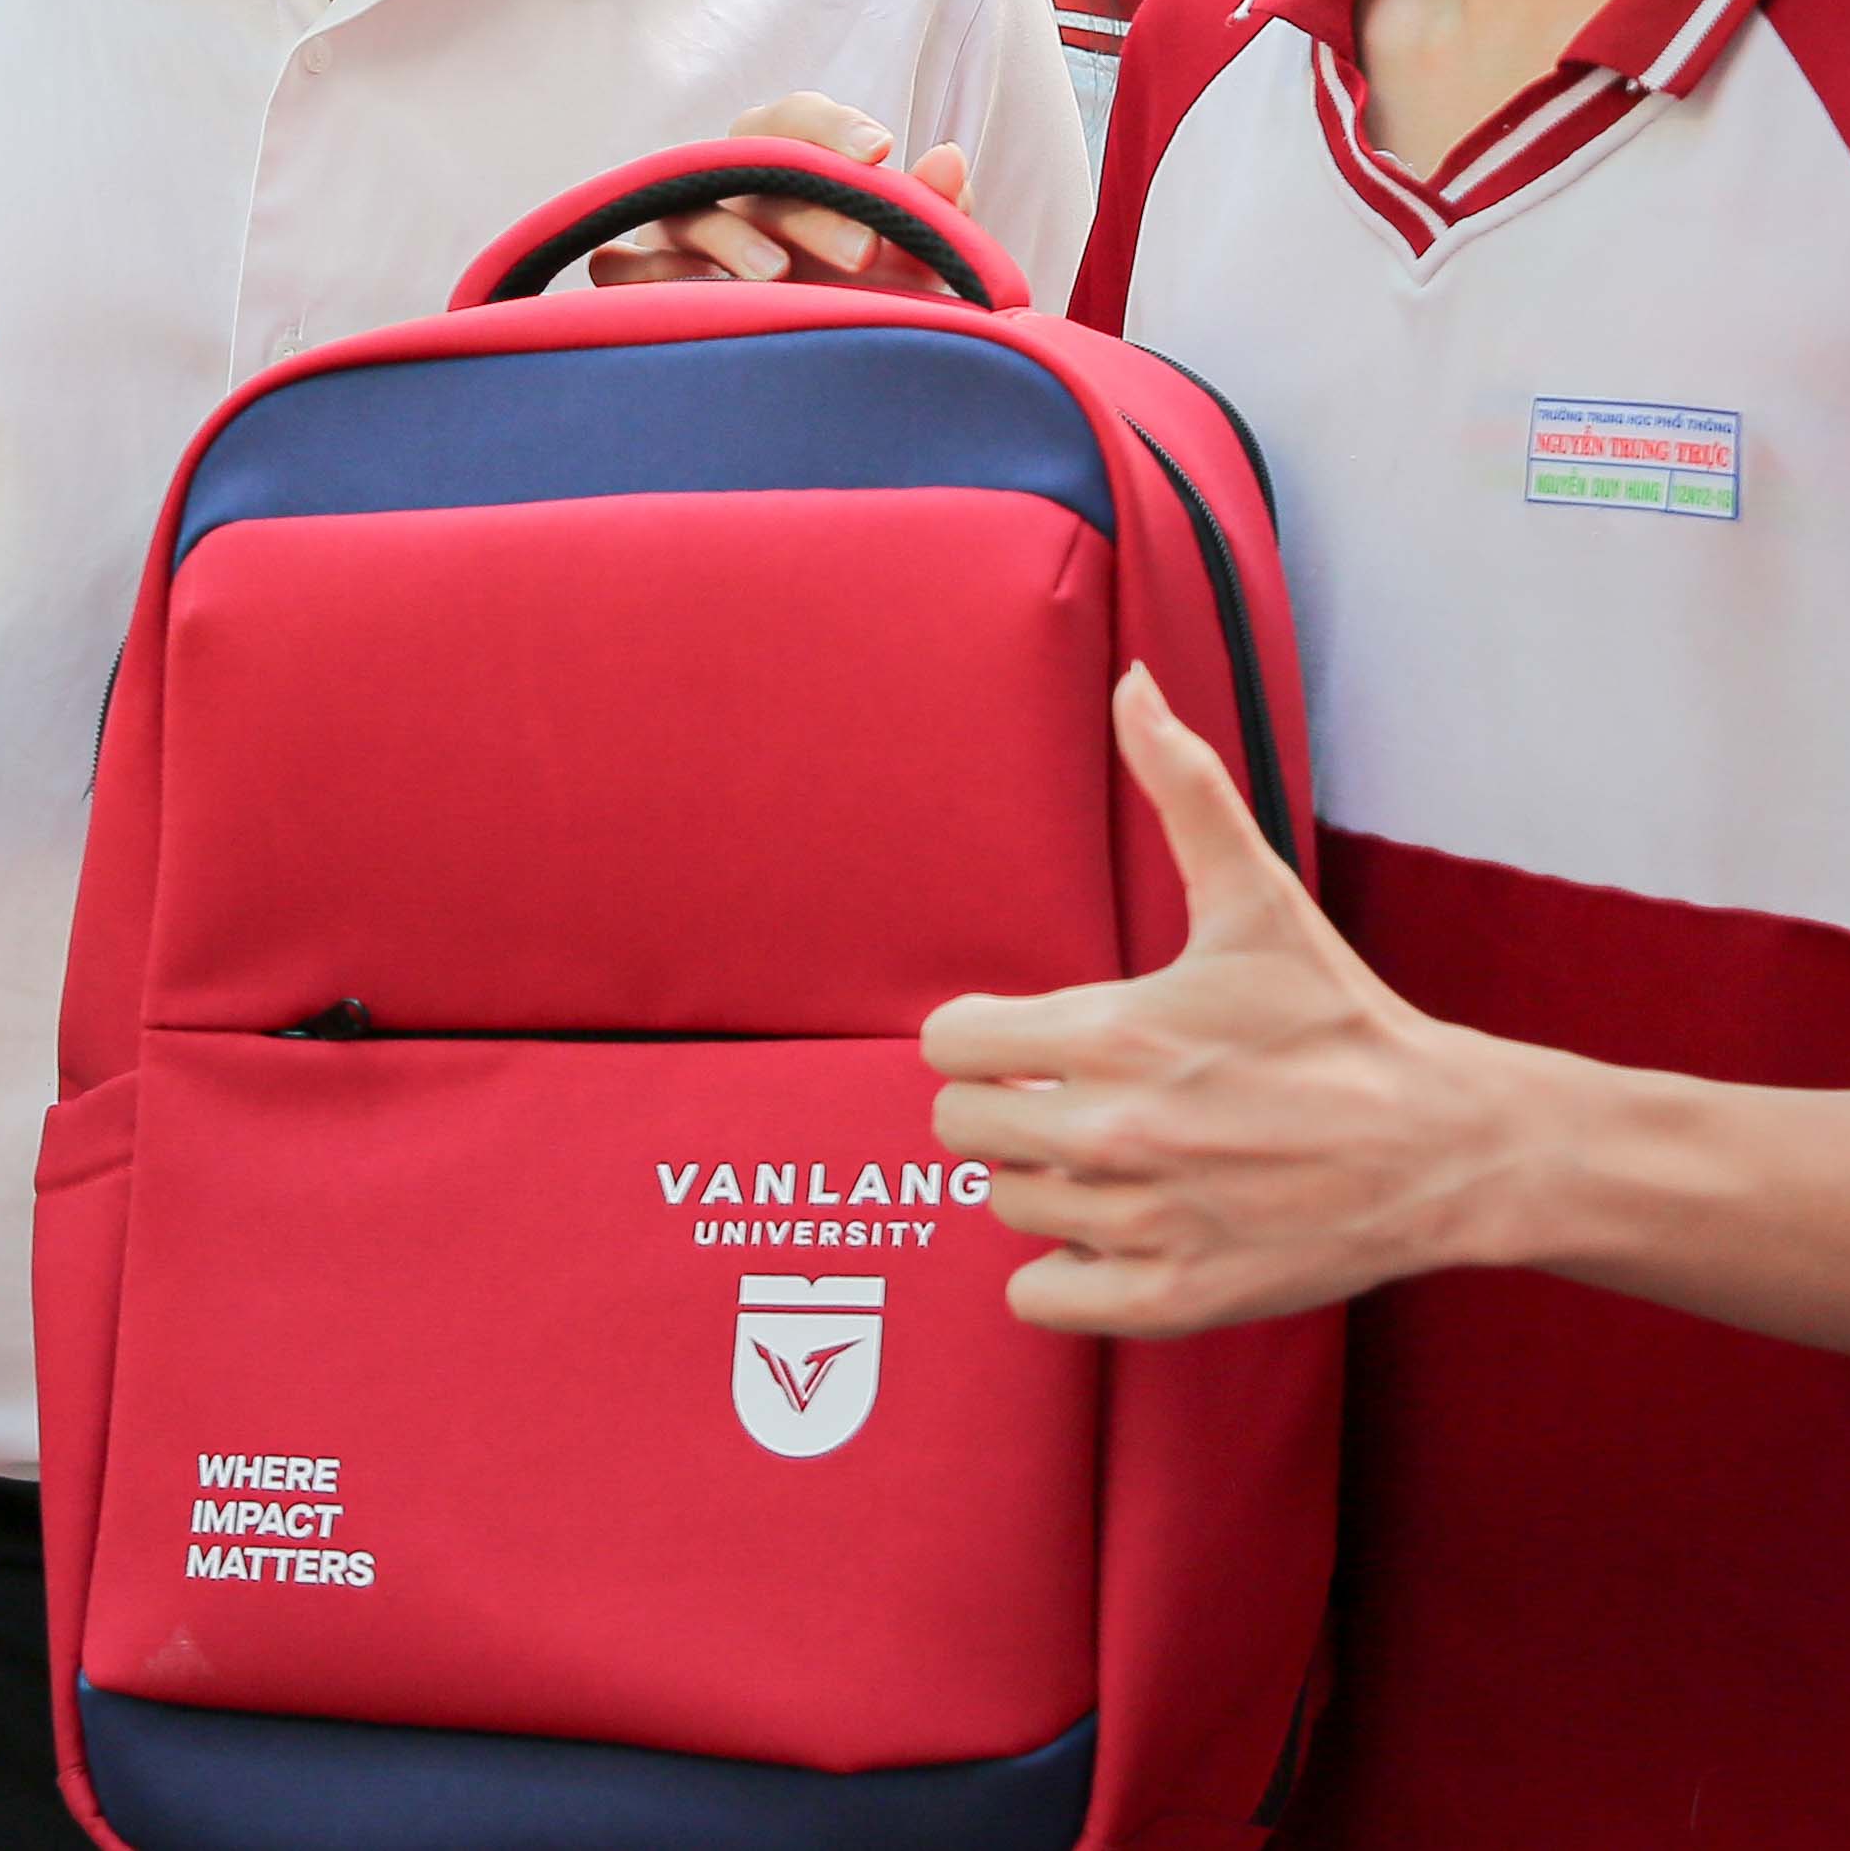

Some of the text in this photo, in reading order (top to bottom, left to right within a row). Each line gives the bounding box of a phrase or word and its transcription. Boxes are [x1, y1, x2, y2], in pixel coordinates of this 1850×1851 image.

[693, 1219, 936, 1248] UNIVERSITY
[197, 1453, 341, 1494] WHERE
[190, 1499, 343, 1540] IMPACT
[185, 1544, 375, 1588] MATTERS
